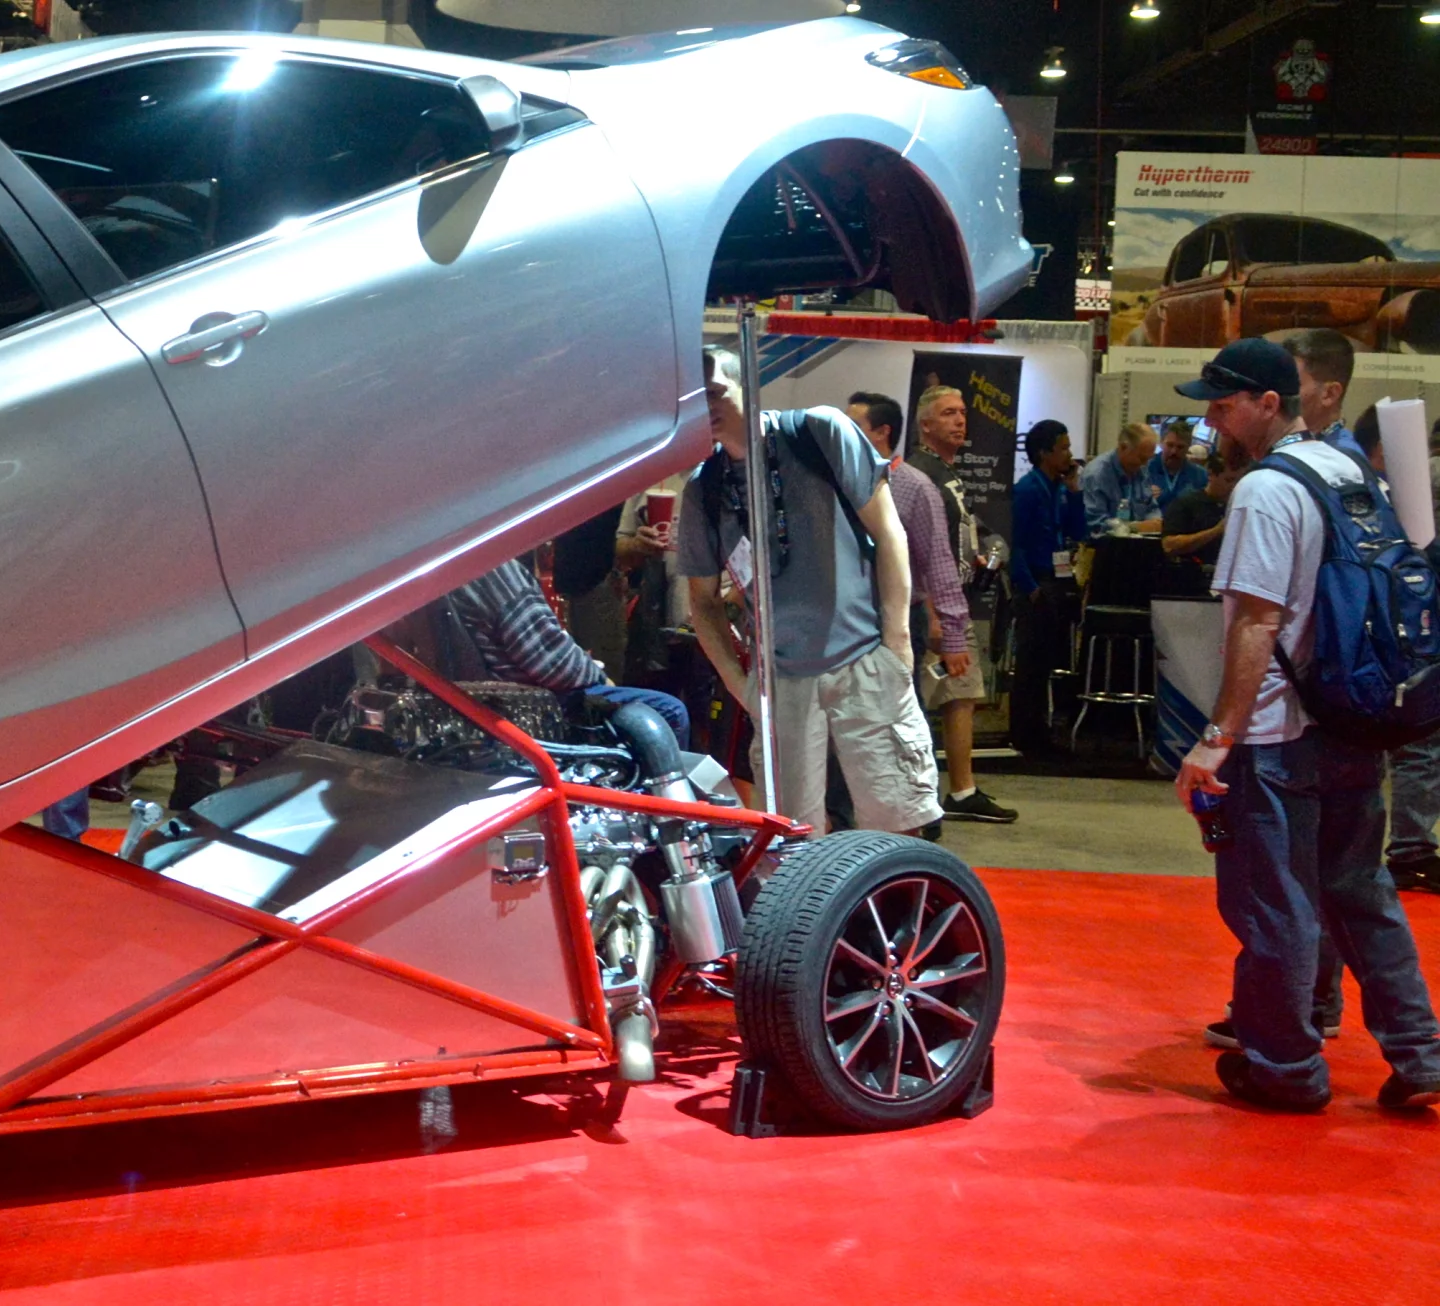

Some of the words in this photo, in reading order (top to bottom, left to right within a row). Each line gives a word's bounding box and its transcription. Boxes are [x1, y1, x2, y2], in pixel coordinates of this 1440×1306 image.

[1138, 164, 1252, 185] Hypertherm
[1133, 187, 1149, 197] Cut
[1152, 188, 1171, 197] with
[1174, 188, 1224, 198] confidence
[969, 370, 1011, 406] Here
[963, 452, 1000, 466] Story
[989, 480, 1007, 493] Ray
